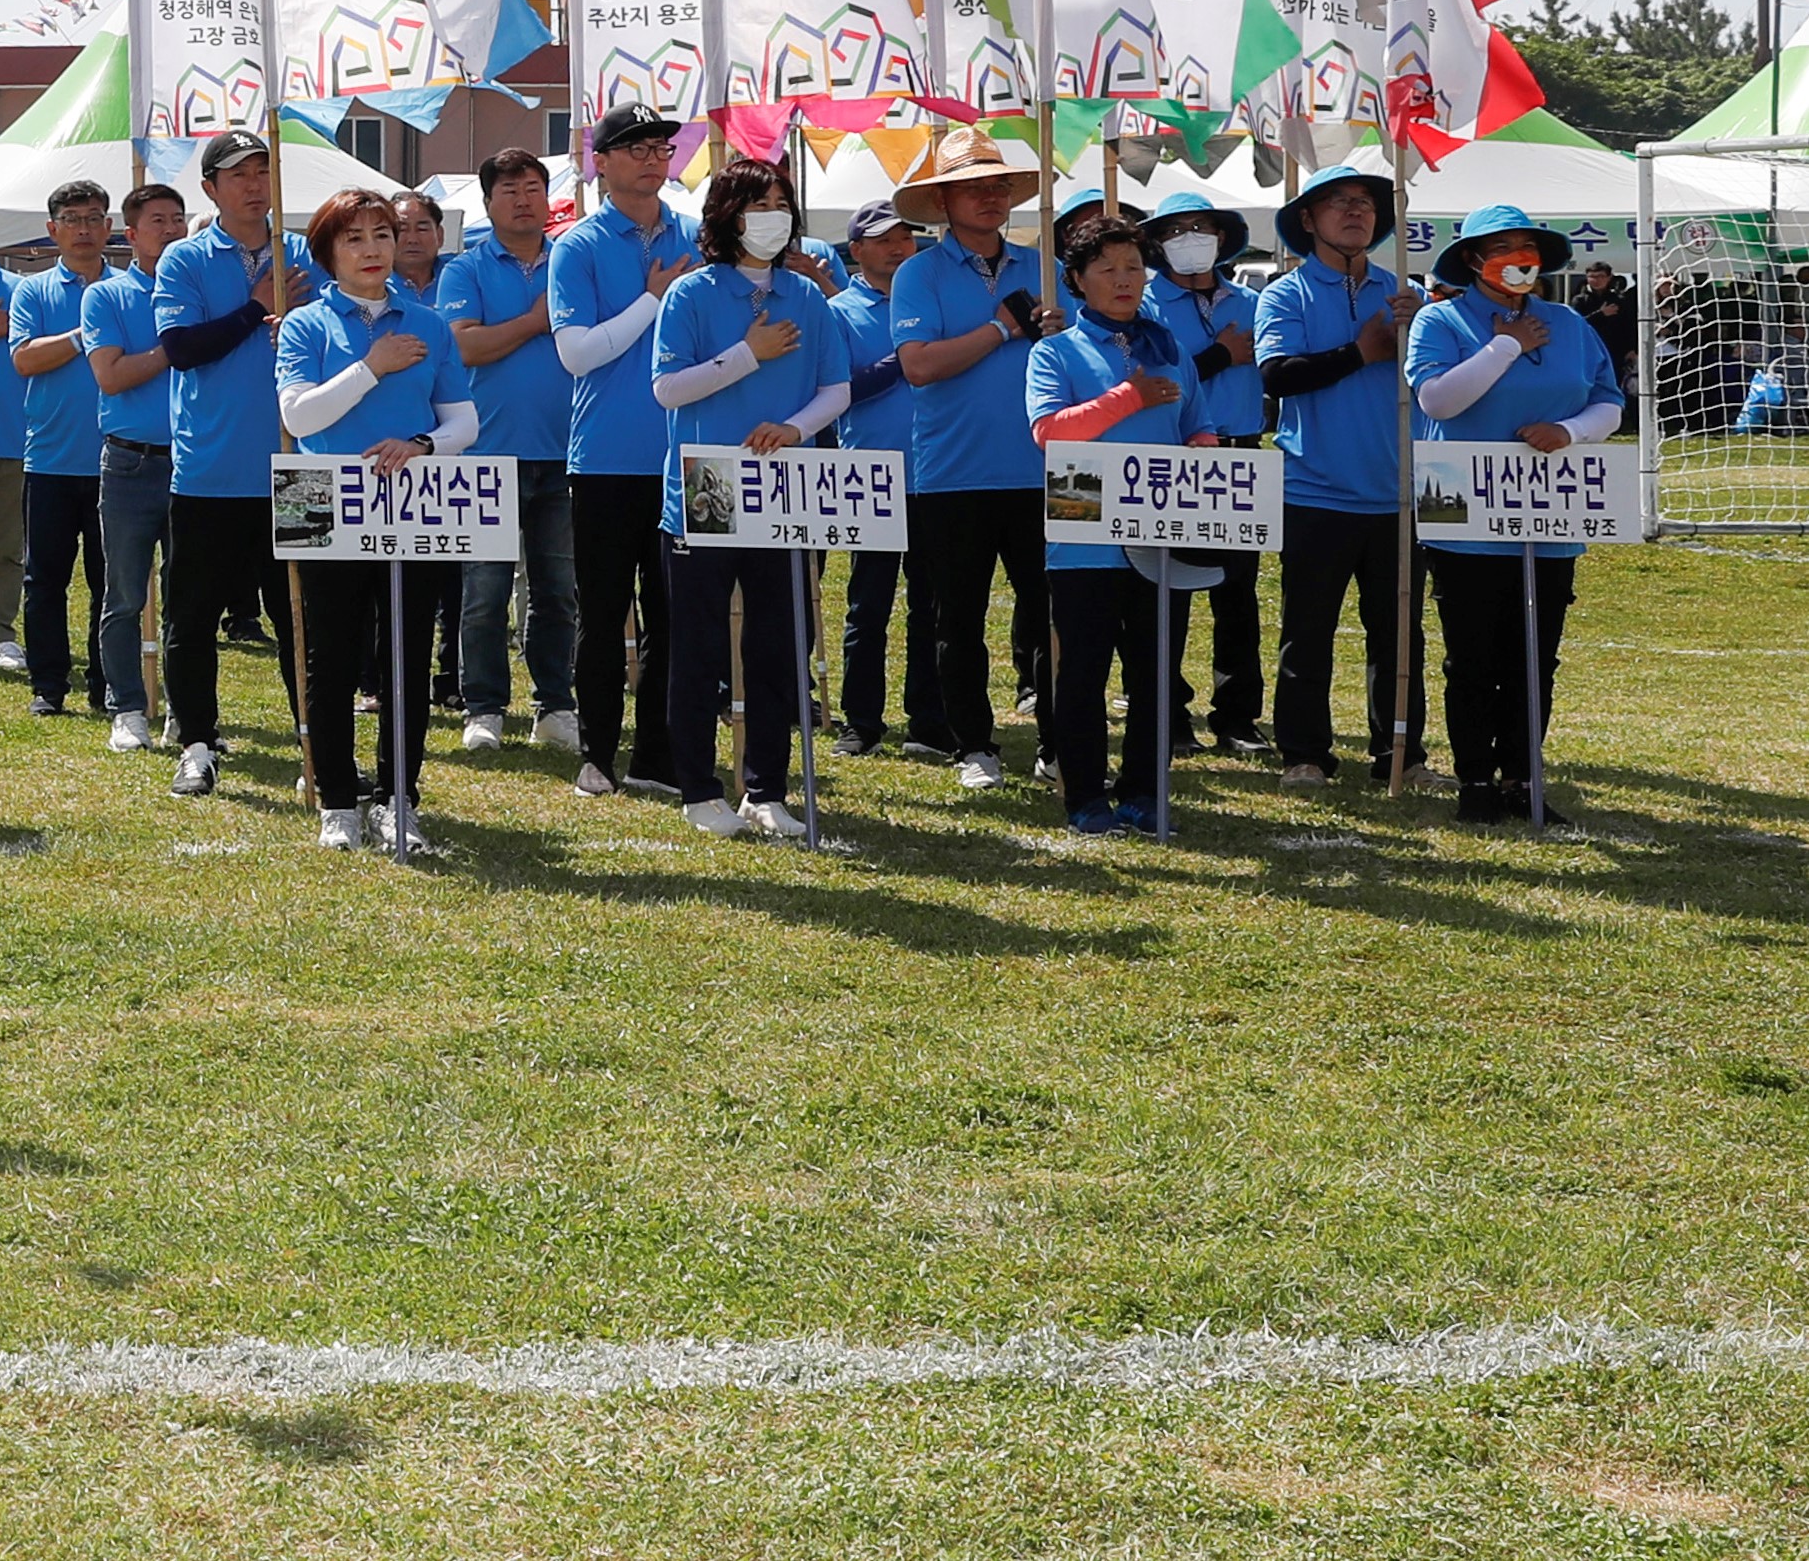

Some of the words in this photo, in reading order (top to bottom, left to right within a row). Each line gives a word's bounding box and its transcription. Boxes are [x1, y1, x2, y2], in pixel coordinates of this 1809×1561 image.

[159, 0, 232, 21] 청정해역
[588, 5, 649, 29] 주산지
[1321, 2, 1350, 25] 있는
[187, 26, 224, 46] 고장
[633, 106, 655, 123] NY
[232, 133, 253, 147] LA
[739, 460, 893, 519] 금계1선수단
[1119, 455, 1257, 513] 오룡선수단
[1473, 454, 1607, 511] 내산선수단
[339, 464, 502, 526] 금계2선수단
[770, 523, 816, 545] 가계,
[825, 525, 862, 546] 용호
[1109, 519, 1147, 540] 유교,
[1197, 521, 1232, 543] 벽파,
[1239, 522, 1269, 545] 연동
[1582, 517, 1618, 537] 황조
[359, 534, 407, 556] 회동,
[414, 534, 472, 555] 금호도
